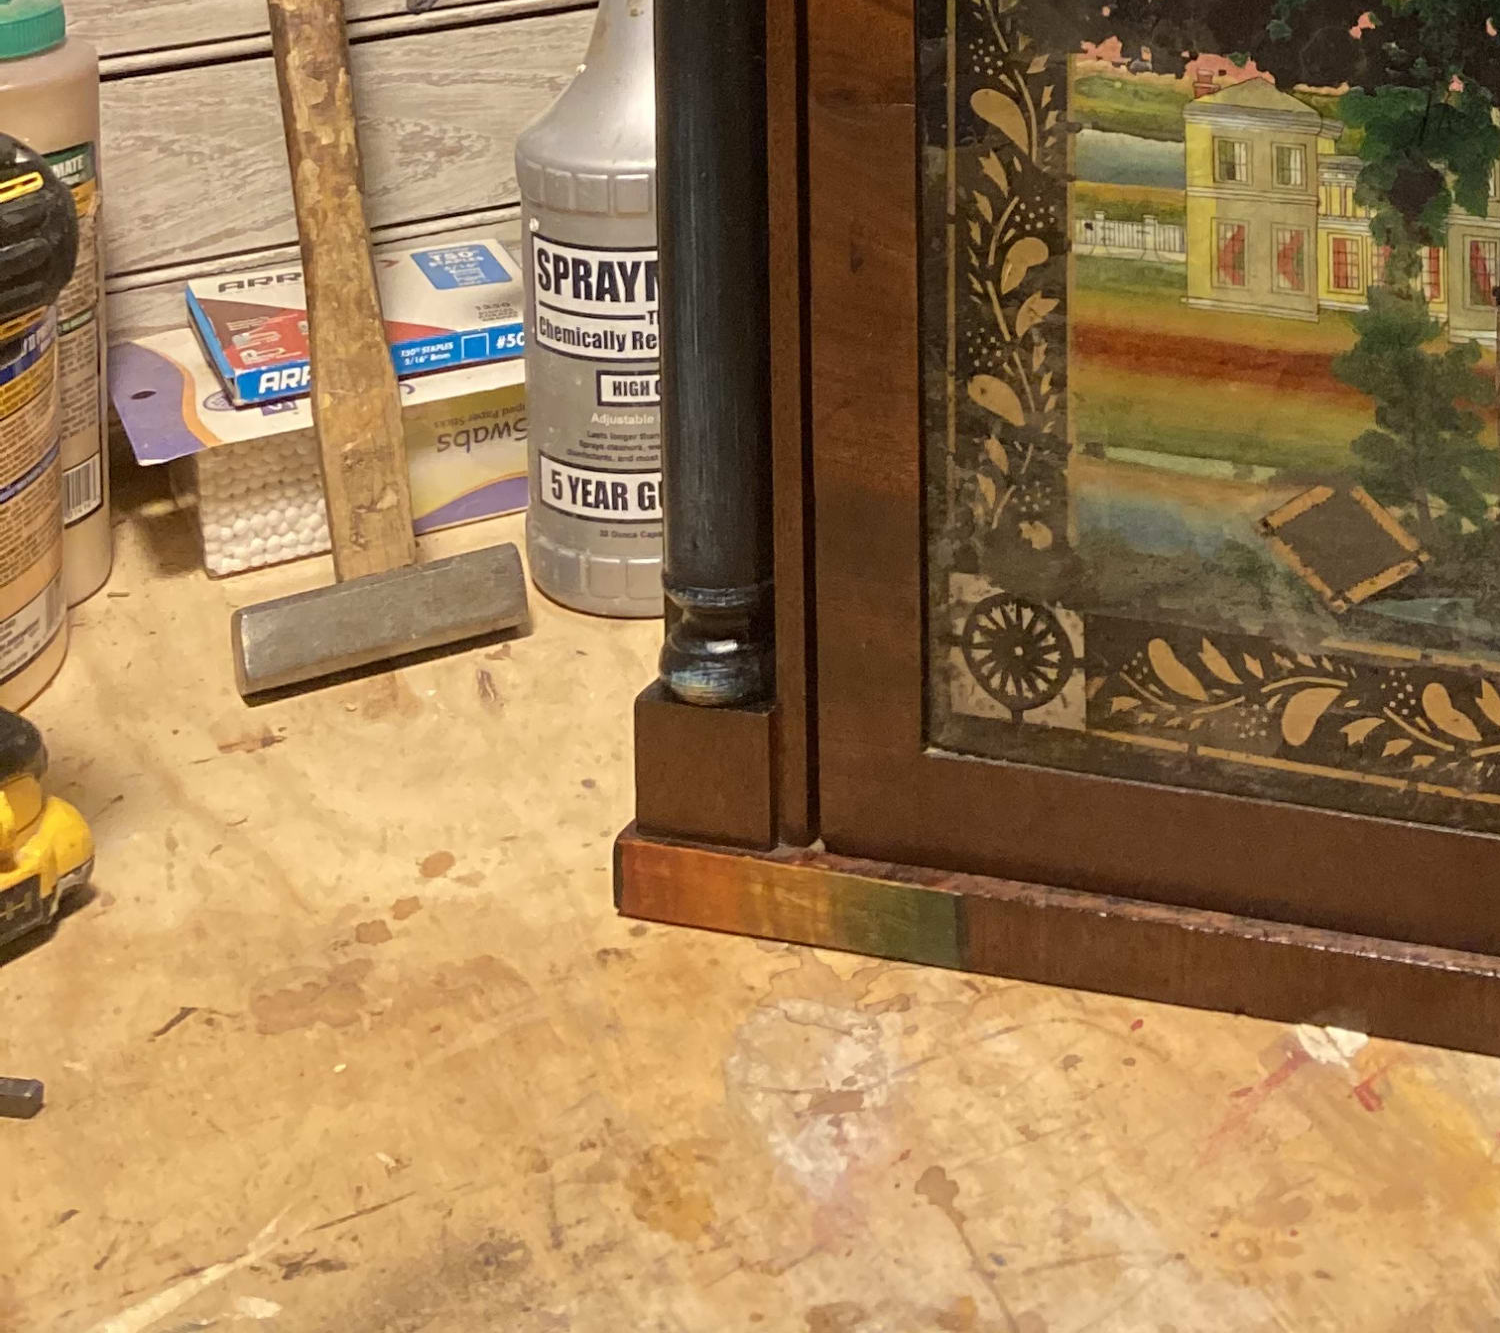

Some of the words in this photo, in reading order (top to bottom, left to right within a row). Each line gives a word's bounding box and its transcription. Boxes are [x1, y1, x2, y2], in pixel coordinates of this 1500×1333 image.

[218, 271, 302, 293] ARR
[538, 315, 627, 353] Chemically
[612, 380, 650, 397] HIGH
[590, 412, 655, 426] Adjustable
[437, 417, 528, 454] Swabs
[551, 468, 564, 501] 5
[567, 475, 628, 511] YEAR
